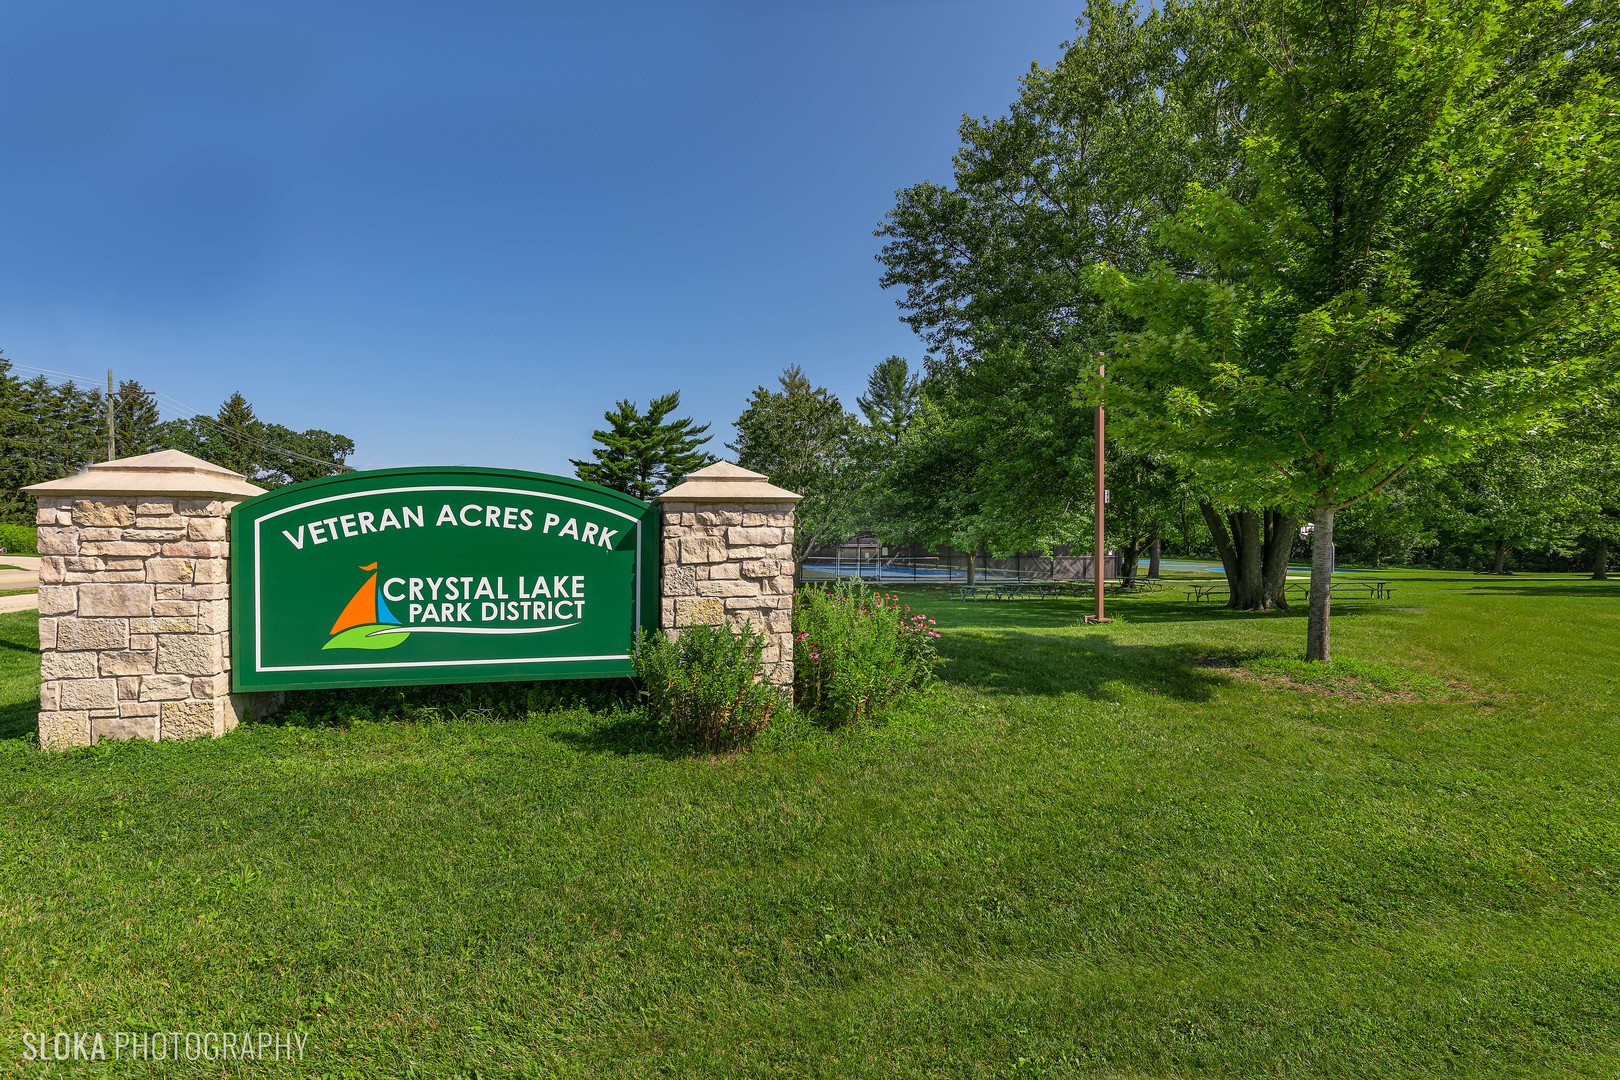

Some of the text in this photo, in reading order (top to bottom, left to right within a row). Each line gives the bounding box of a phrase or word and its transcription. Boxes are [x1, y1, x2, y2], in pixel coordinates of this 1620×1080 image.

[282, 504, 619, 551] VETERAN ACRES PARK
[382, 575, 586, 602] CRYSTAL LAKE
[408, 600, 586, 623] PARK DISTRICT
